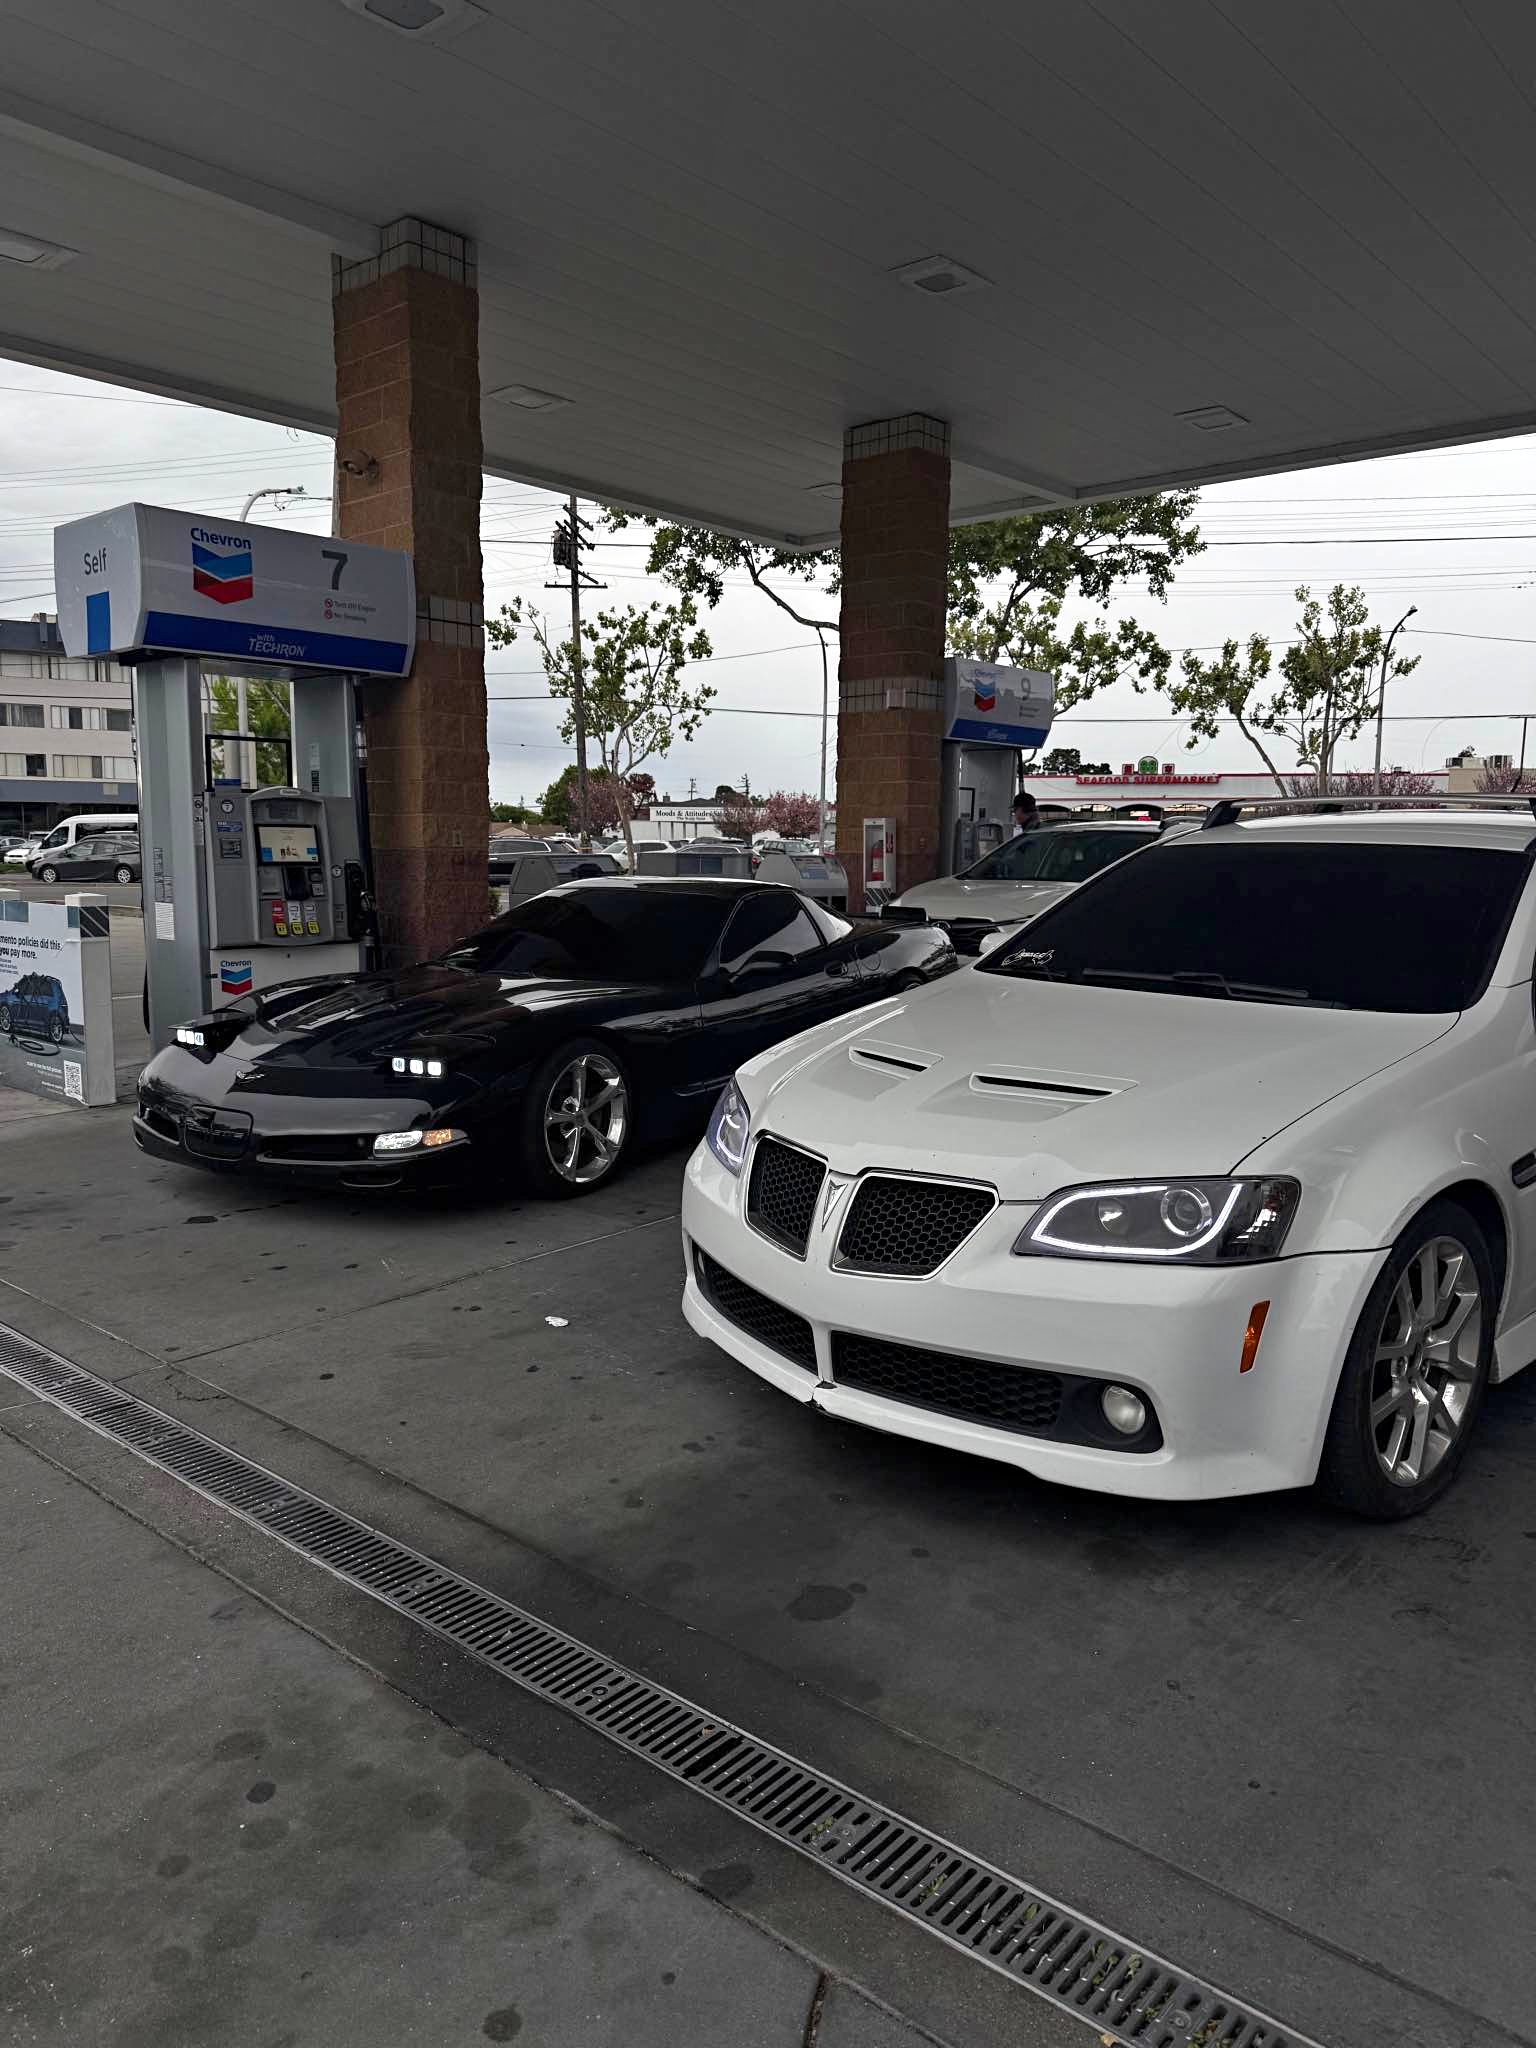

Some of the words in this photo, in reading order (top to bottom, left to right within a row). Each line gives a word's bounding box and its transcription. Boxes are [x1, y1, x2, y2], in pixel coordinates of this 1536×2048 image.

[190, 528, 252, 549] Chevron
[84, 548, 107, 575] Self
[322, 550, 348, 591] 7
[248, 638, 305, 657] TECHRON
[1020, 677, 1031, 701] 9
[1076, 775, 1129, 785] SEAFOOD
[1134, 774, 1221, 785] SUPERMARKET
[18, 936, 39, 948] policies
[40, 938, 49, 949] did
[10, 948, 20, 959] pay
[21, 949, 37, 960] more.
[220, 960, 252, 968] Chevron
